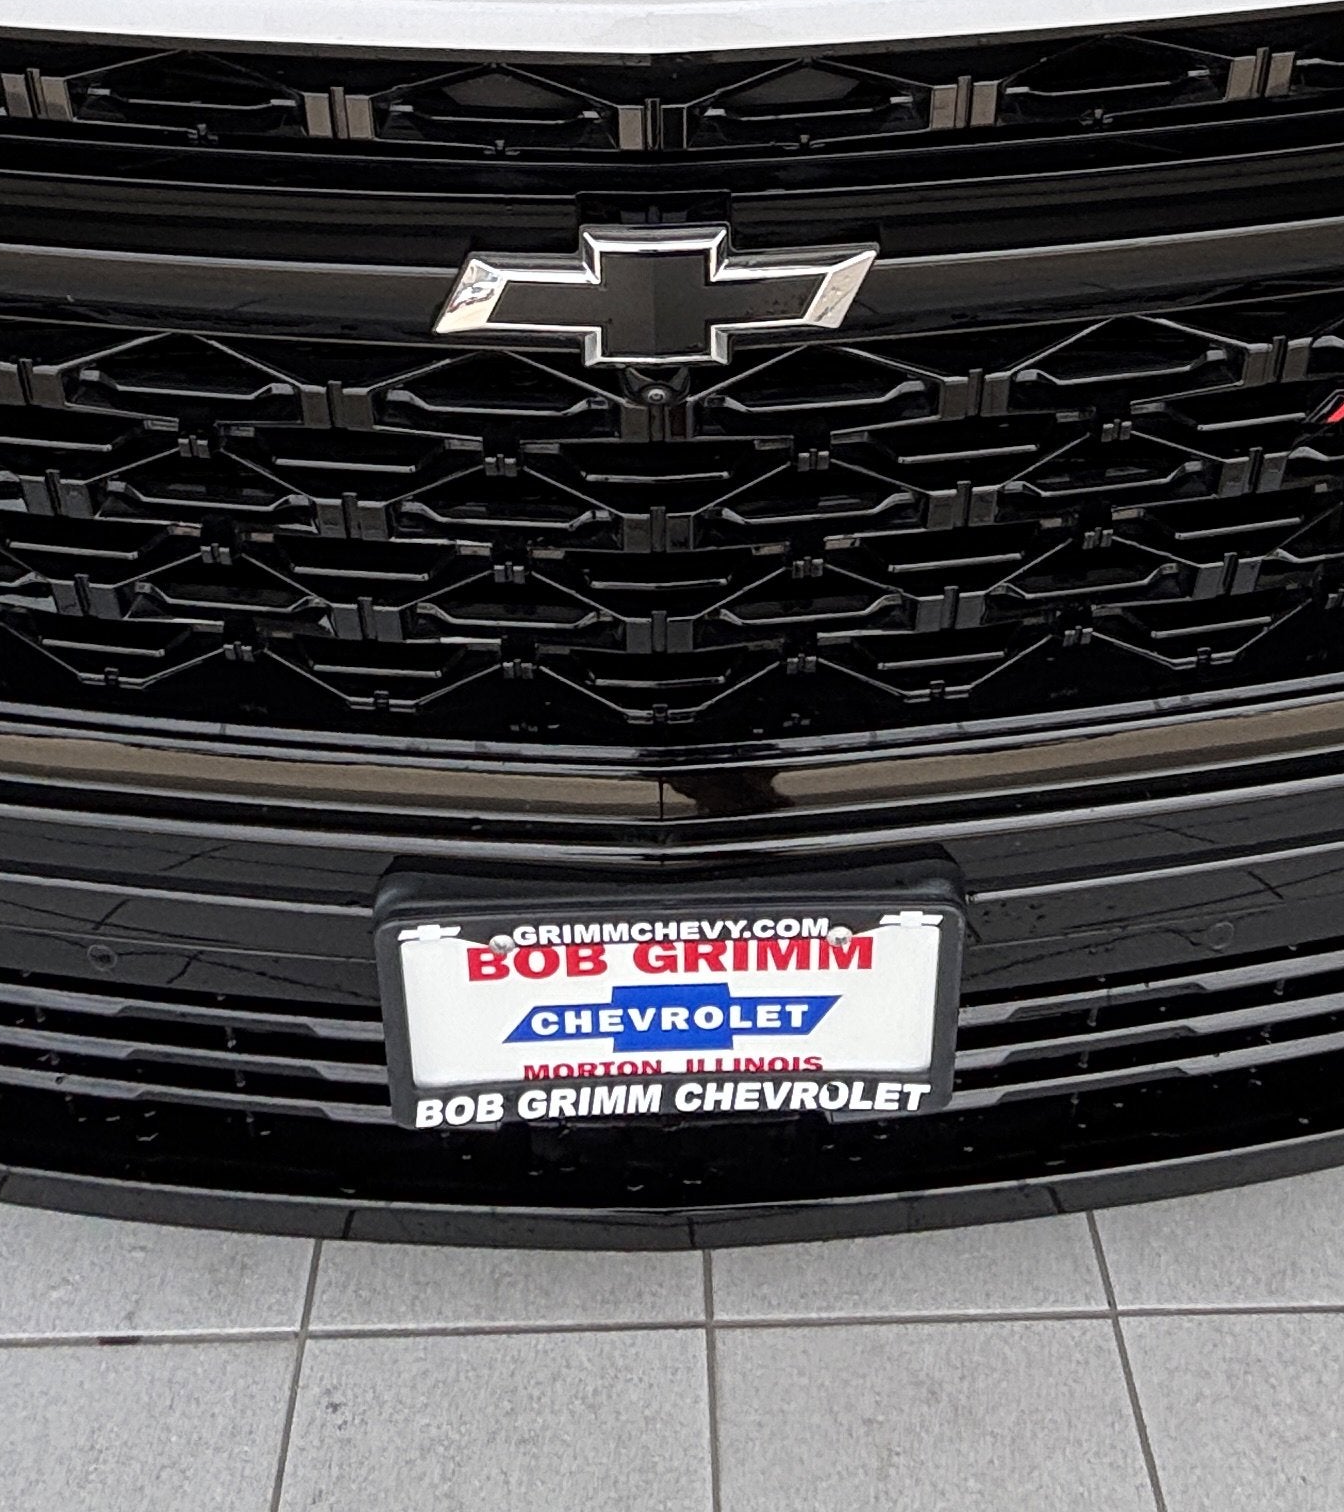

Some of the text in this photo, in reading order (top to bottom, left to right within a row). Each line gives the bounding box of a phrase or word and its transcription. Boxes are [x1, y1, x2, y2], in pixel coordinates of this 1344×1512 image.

[512, 918, 830, 946] GRIMMCHEVY.COM
[467, 936, 873, 981] BOB GRIMM
[530, 1004, 809, 1036] CHEVROLET
[523, 1056, 824, 1081] MORTON ILLINOIS
[415, 1080, 931, 1128] BOB GRIMM CHEVROLET
